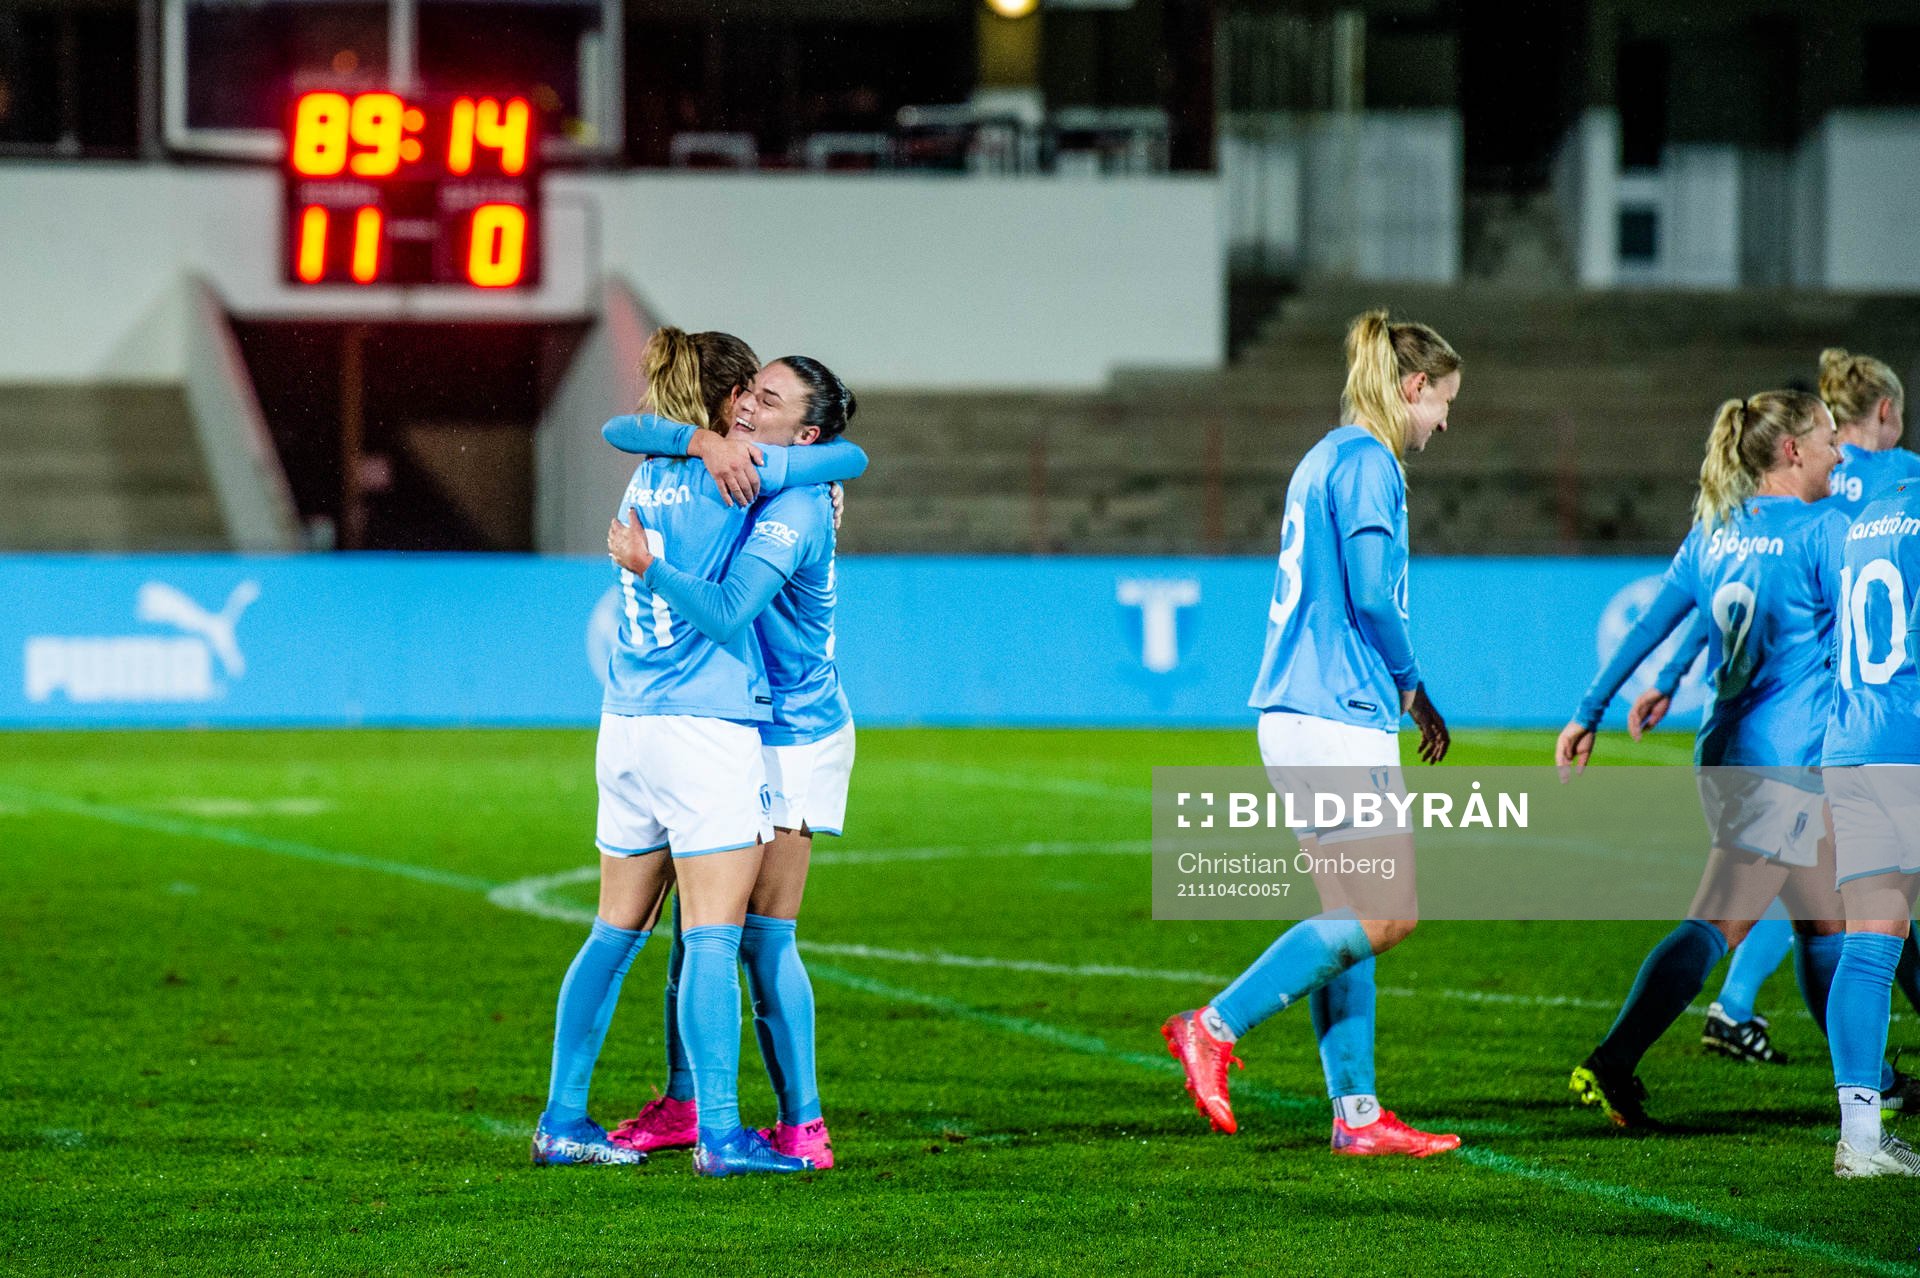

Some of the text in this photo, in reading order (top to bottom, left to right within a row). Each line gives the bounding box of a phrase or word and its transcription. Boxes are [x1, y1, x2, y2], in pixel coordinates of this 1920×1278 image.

[297, 201, 527, 289] 11 0
[1830, 472, 1863, 502] dig
[1847, 511, 1920, 541] arström
[1707, 528, 1784, 562] Sjögren
[1840, 559, 1907, 690] 10
